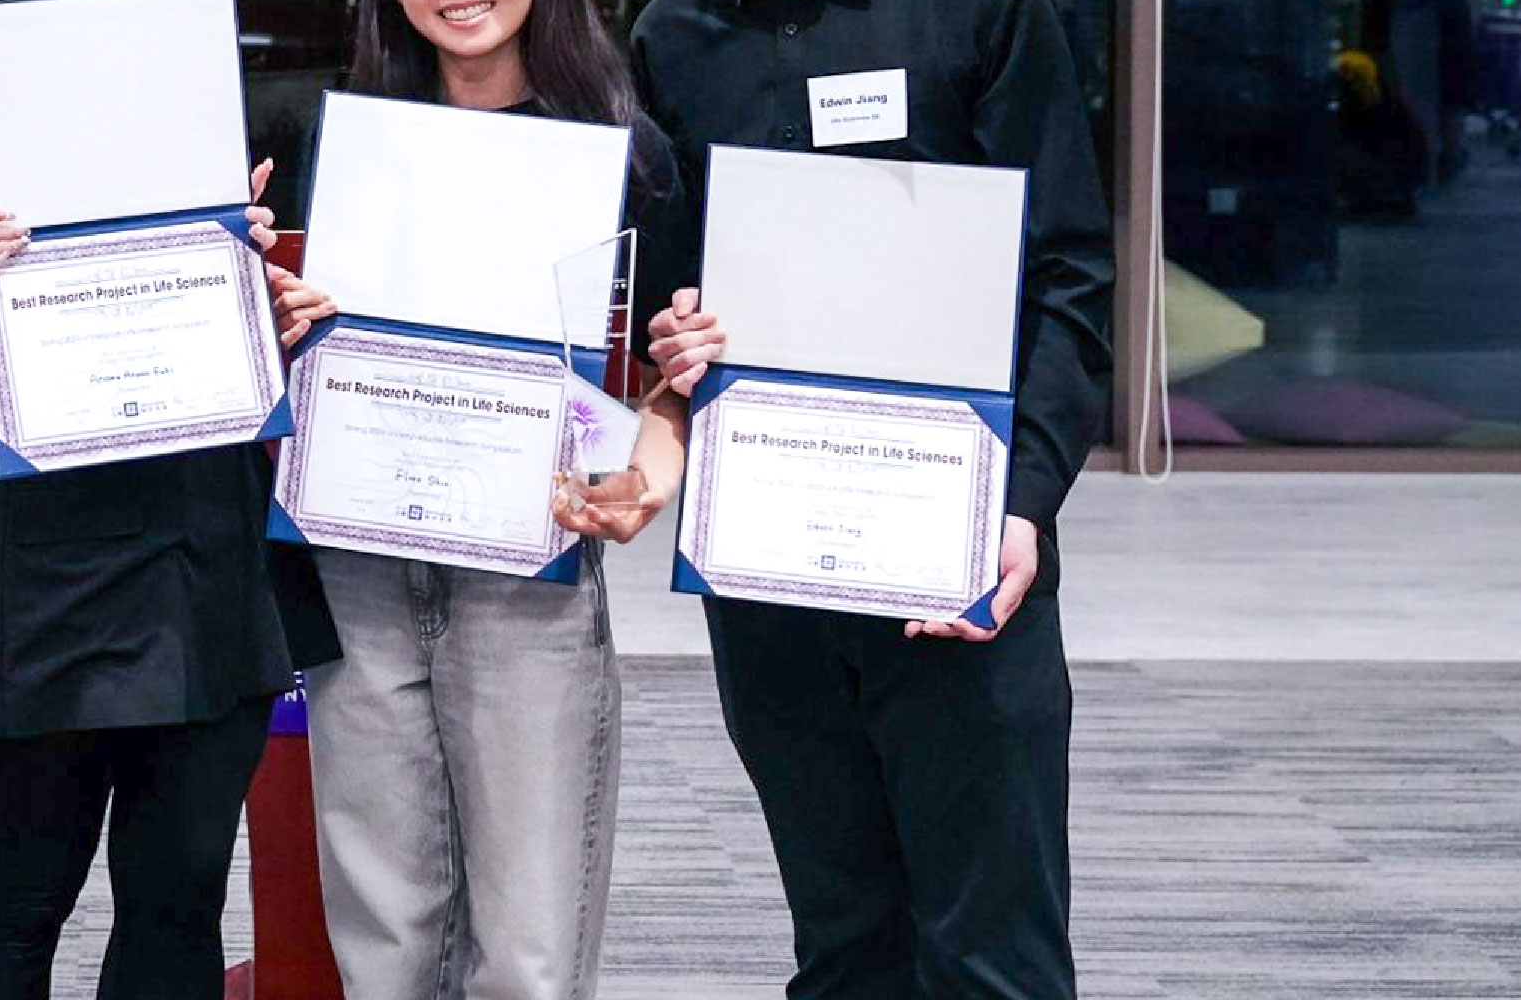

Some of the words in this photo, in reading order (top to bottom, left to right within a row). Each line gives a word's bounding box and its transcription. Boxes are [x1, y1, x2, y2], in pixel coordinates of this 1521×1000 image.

[820, 97, 853, 109] Edwin
[856, 94, 888, 105] Jiang
[11, 296, 37, 311] Best
[38, 291, 94, 306] Research
[96, 284, 138, 301] Project
[140, 281, 151, 294] in
[154, 279, 173, 293] Life
[175, 274, 227, 290] Sciences
[325, 378, 351, 392] Best
[354, 381, 410, 399] Research
[412, 388, 455, 408] Project
[457, 395, 470, 408] in
[472, 397, 494, 411] Life
[495, 400, 550, 419] Sciences
[731, 430, 757, 444] Best
[761, 433, 817, 450] Research
[821, 439, 864, 456] Project
[868, 444, 879, 457] in
[883, 445, 903, 460] Life
[907, 448, 963, 466] Sciences
